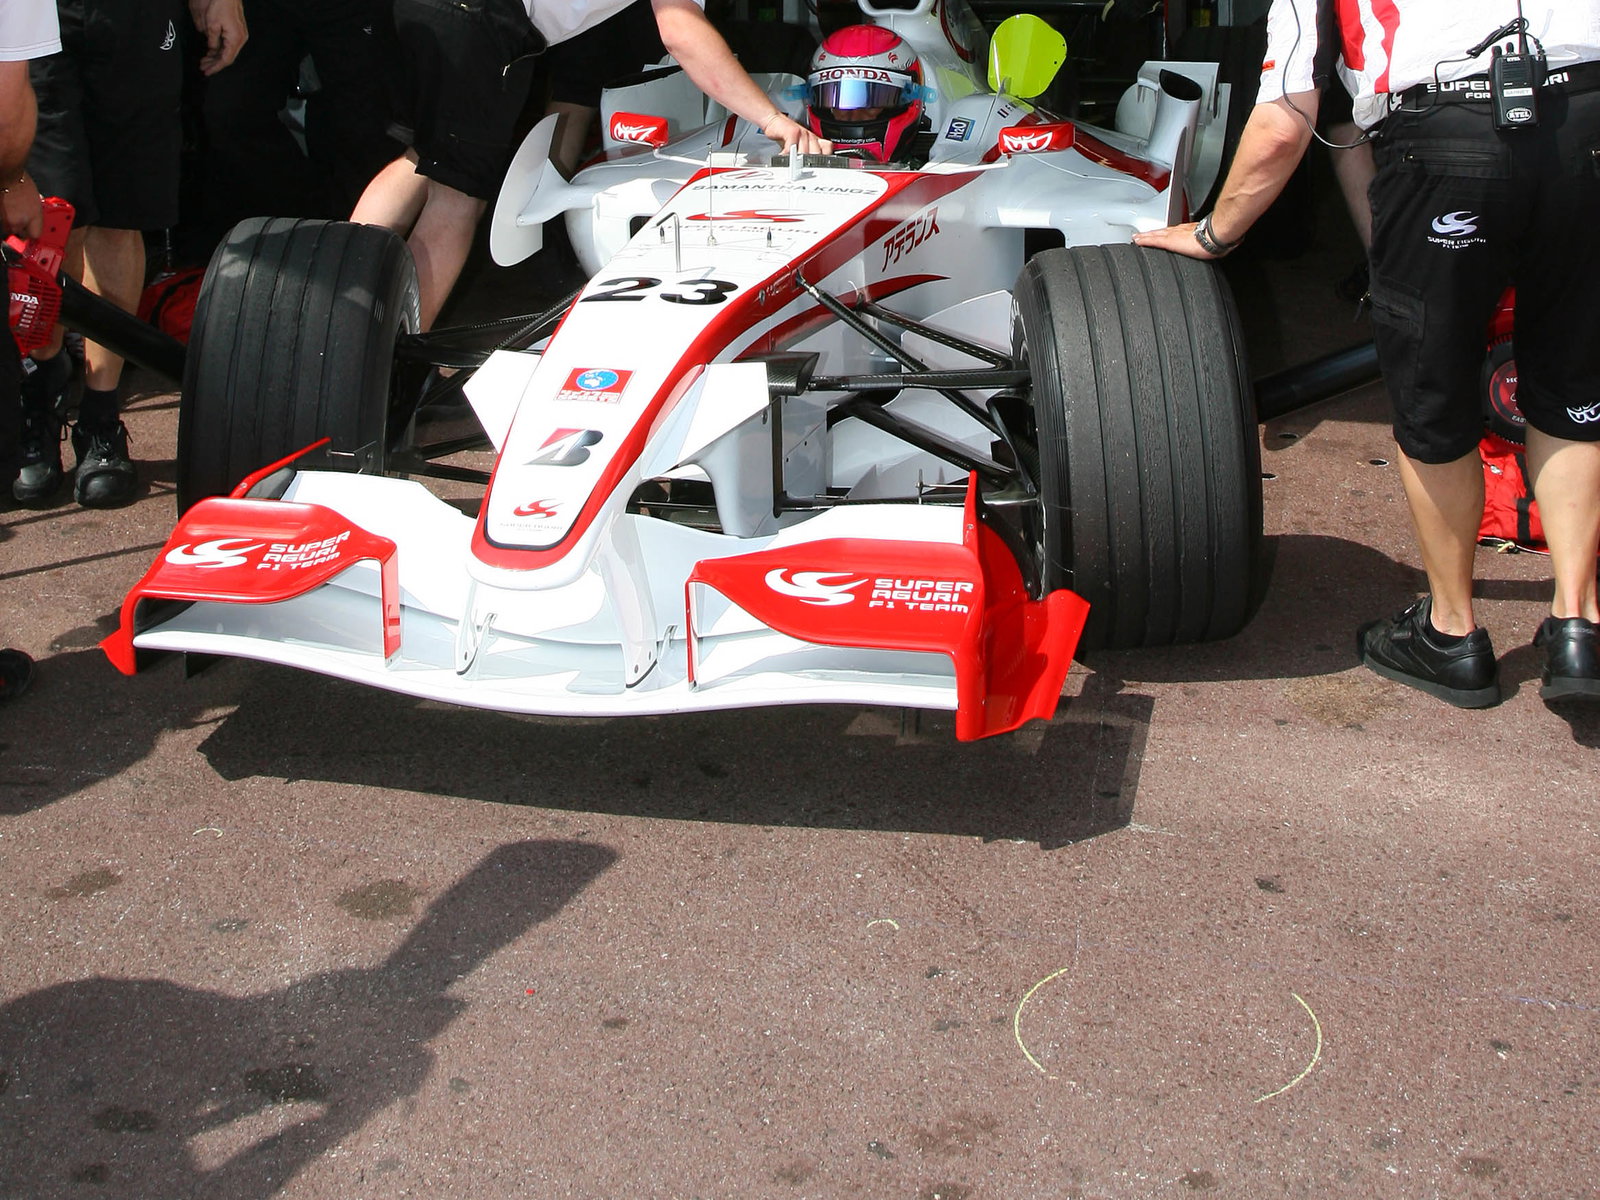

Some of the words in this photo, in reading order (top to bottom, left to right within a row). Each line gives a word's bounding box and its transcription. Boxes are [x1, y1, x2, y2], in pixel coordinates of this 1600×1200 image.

[818, 68, 893, 83] HONDA
[814, 186, 879, 195] KINGZ
[10, 291, 39, 304] NDA
[579, 276, 739, 305] 23
[268, 530, 350, 553] SUPER
[256, 562, 281, 571] F1
[290, 551, 341, 570] TEAM
[262, 544, 338, 563] AGURI
[874, 578, 974, 593] SUPER
[871, 589, 959, 603] AGURI
[868, 600, 895, 609] F1
[905, 601, 969, 614] TEAM
